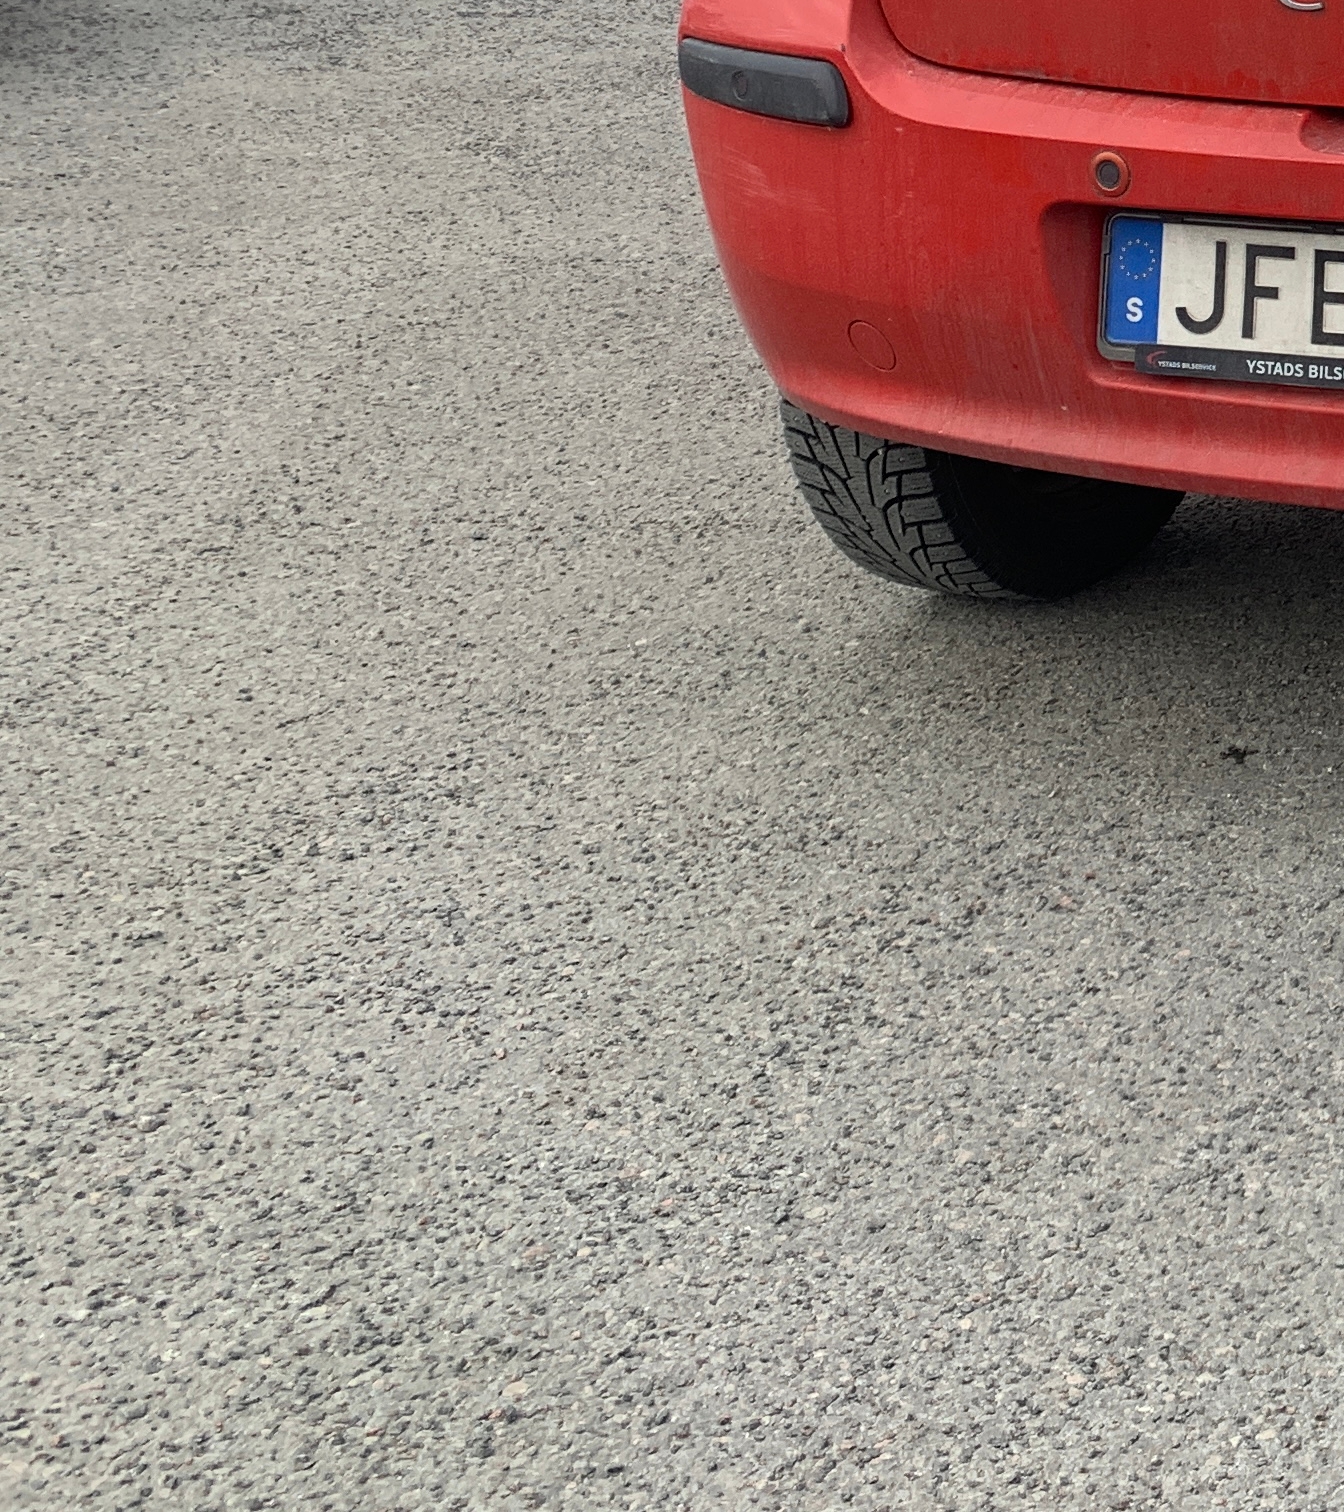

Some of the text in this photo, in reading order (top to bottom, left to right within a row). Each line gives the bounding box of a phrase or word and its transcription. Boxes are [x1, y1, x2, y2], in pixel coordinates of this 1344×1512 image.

[1125, 296, 1144, 323] S
[1157, 360, 1217, 372] YSTADS BILSERVICE
[1246, 359, 1304, 378] YSTADS
